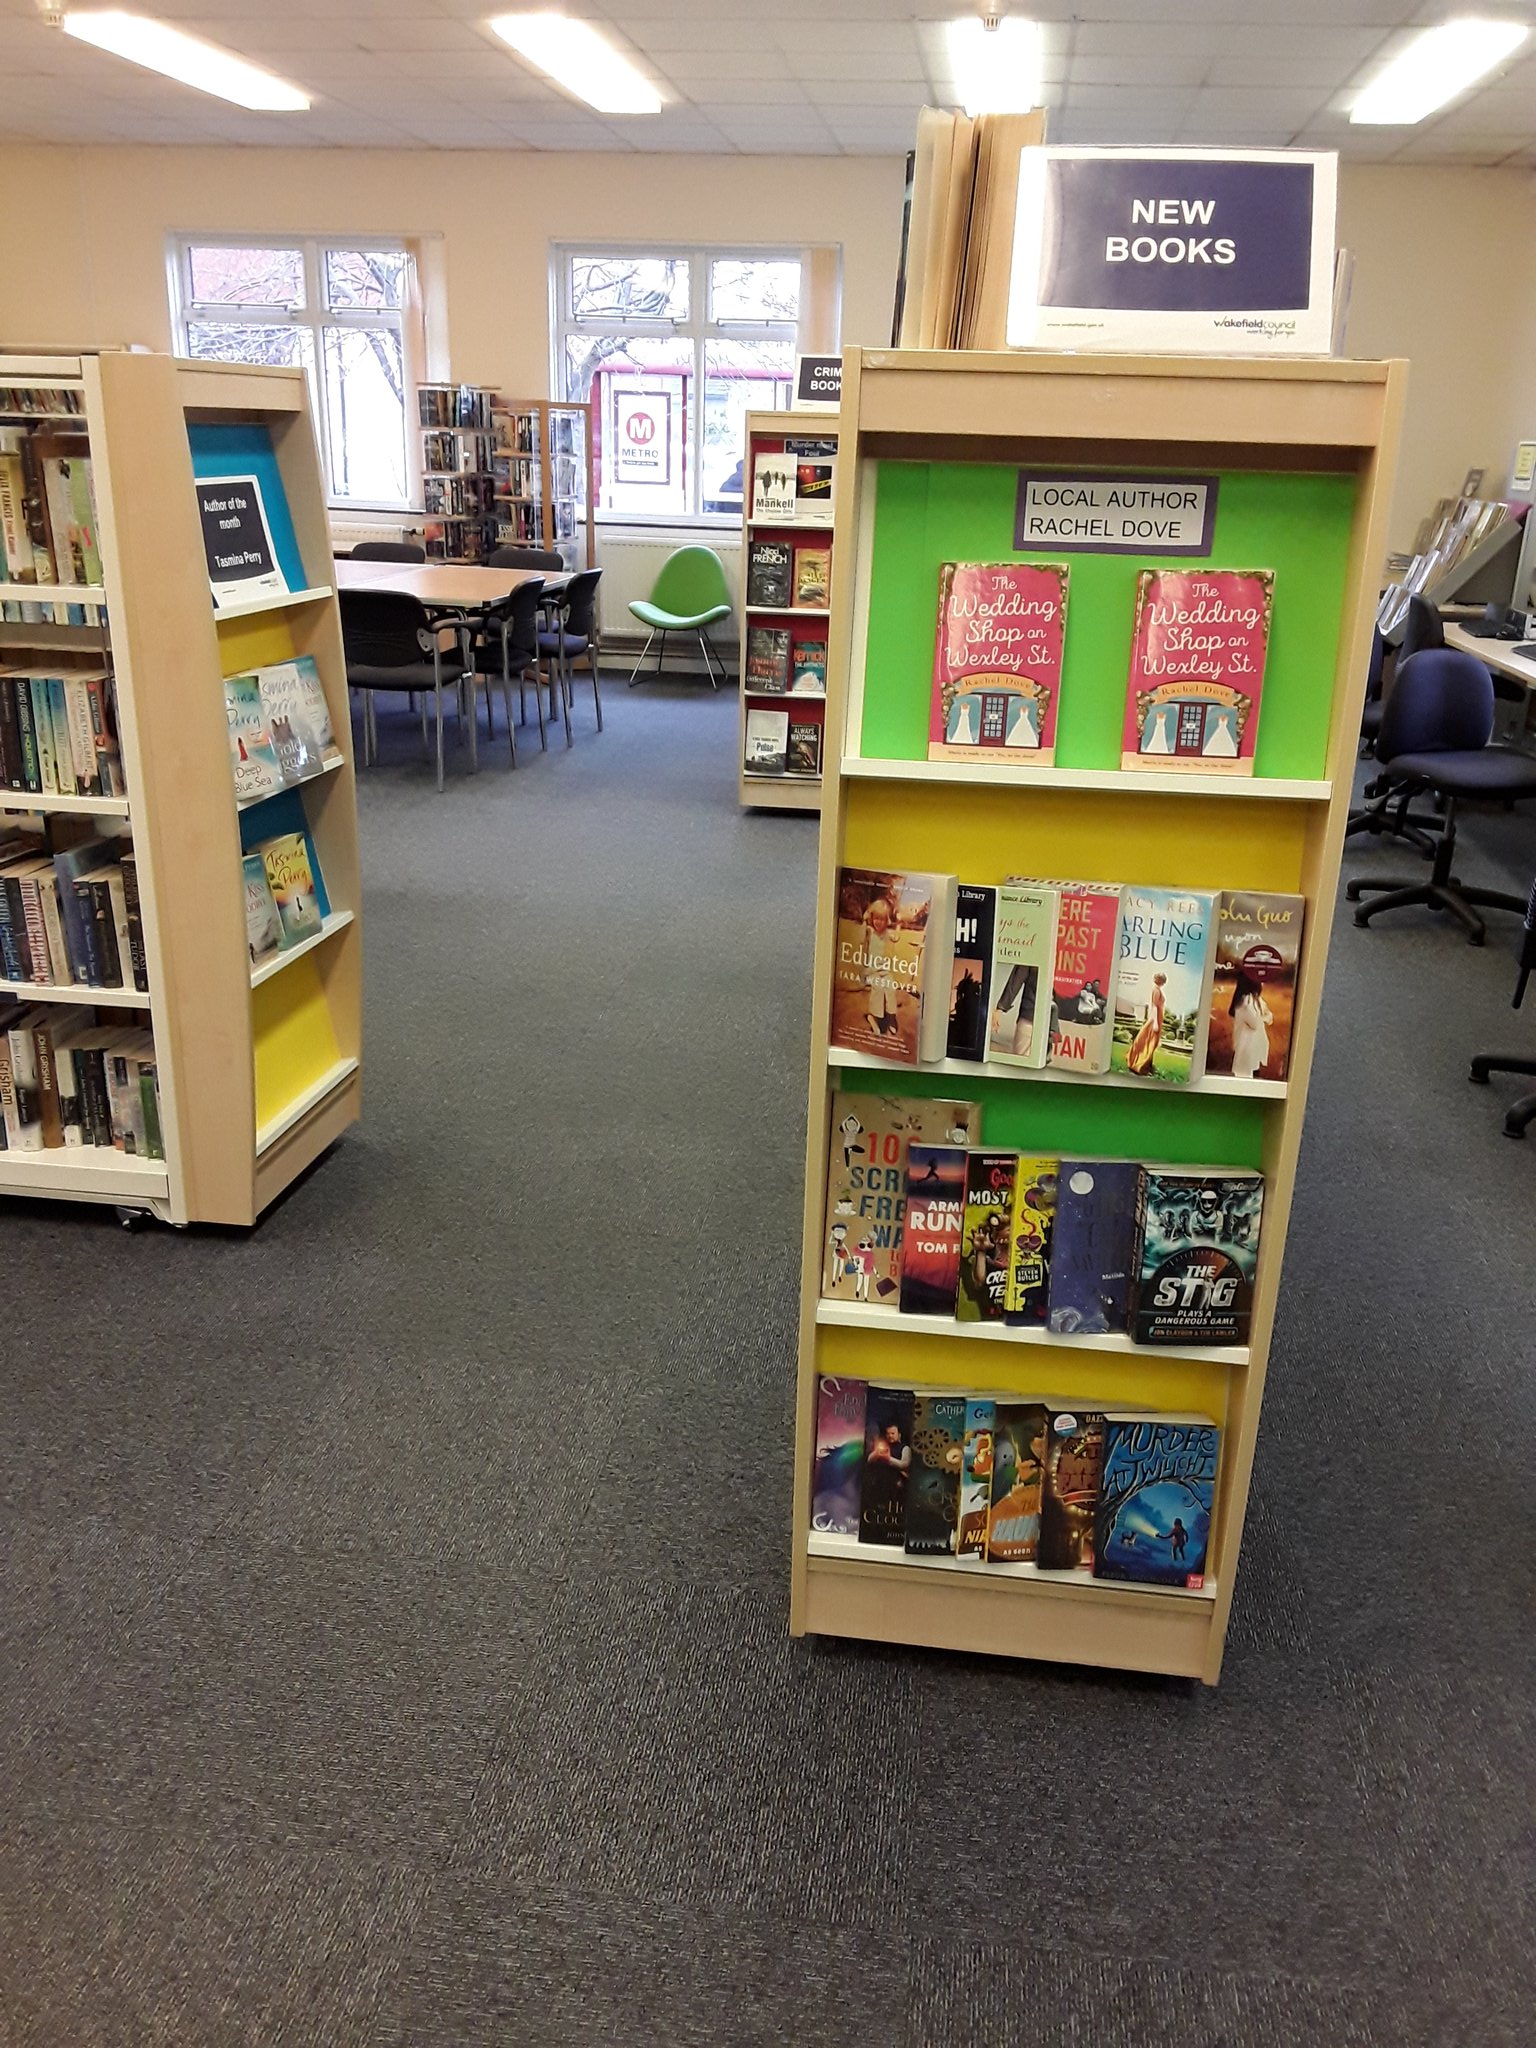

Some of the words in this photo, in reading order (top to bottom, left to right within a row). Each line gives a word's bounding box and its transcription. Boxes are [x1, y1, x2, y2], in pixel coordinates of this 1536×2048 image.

[1132, 199, 1215, 225] NEW
[1105, 236, 1236, 264] BOOKS
[622, 448, 659, 458] METRO
[204, 499, 228, 513] Author
[227, 497, 235, 510] of
[235, 497, 247, 509] the
[756, 498, 793, 508] Mankell
[1032, 488, 1100, 507] LOCAL
[1107, 490, 1198, 510] AUTHOR
[219, 516, 241, 530] month
[1029, 517, 1114, 537] RACHEL
[1121, 519, 1182, 539] DOVE
[214, 553, 244, 568] Tasmina
[245, 551, 262, 565] Perry
[753, 554, 787, 564] FRENCH
[991, 576, 1017, 592] The
[1191, 583, 1219, 598] The
[950, 594, 1057, 622] Wedding
[1148, 600, 1260, 629] Wedding
[965, 620, 1023, 646] Shop
[1027, 629, 1047, 640] on
[1163, 627, 1225, 653] Shop
[1228, 635, 1249, 647] on
[945, 644, 1023, 671] Wexley
[1027, 648, 1056, 665] St.
[1141, 652, 1223, 680] Wexley
[1228, 656, 1257, 673] St.
[965, 677, 1000, 687] Rachel
[1005, 677, 1031, 688] Dove
[1161, 685, 1198, 696] Rachel
[1204, 686, 1231, 697] Dove
[17, 682, 27, 704] DAVID
[791, 734, 818, 742] WATCHING
[794, 727, 815, 735] ALWAYS
[236, 765, 262, 779] Deep
[235, 781, 253, 794] Blue
[255, 777, 272, 789] Sea
[962, 890, 985, 901] Library
[1257, 905, 1293, 929] Guo
[1057, 924, 1101, 950] PAST
[1225, 932, 1262, 950] upon
[841, 942, 919, 977] Educated
[1119, 934, 1187, 965] BLUE
[839, 969, 862, 983] TARA
[866, 975, 917, 994] WESTOVER
[37, 1034, 45, 1054] JOHN
[0, 1059, 13, 1105] Grisham
[40, 1055, 51, 1091] GRISHAM
[867, 1131, 921, 1165] 10
[968, 1190, 1009, 1206] MOST
[917, 1241, 948, 1254] TOM
[1186, 1265, 1217, 1279] THE
[1154, 1317, 1207, 1325] DANGEROUS
[1210, 1317, 1235, 1325] GAME
[1108, 1422, 1215, 1456] MURDER
